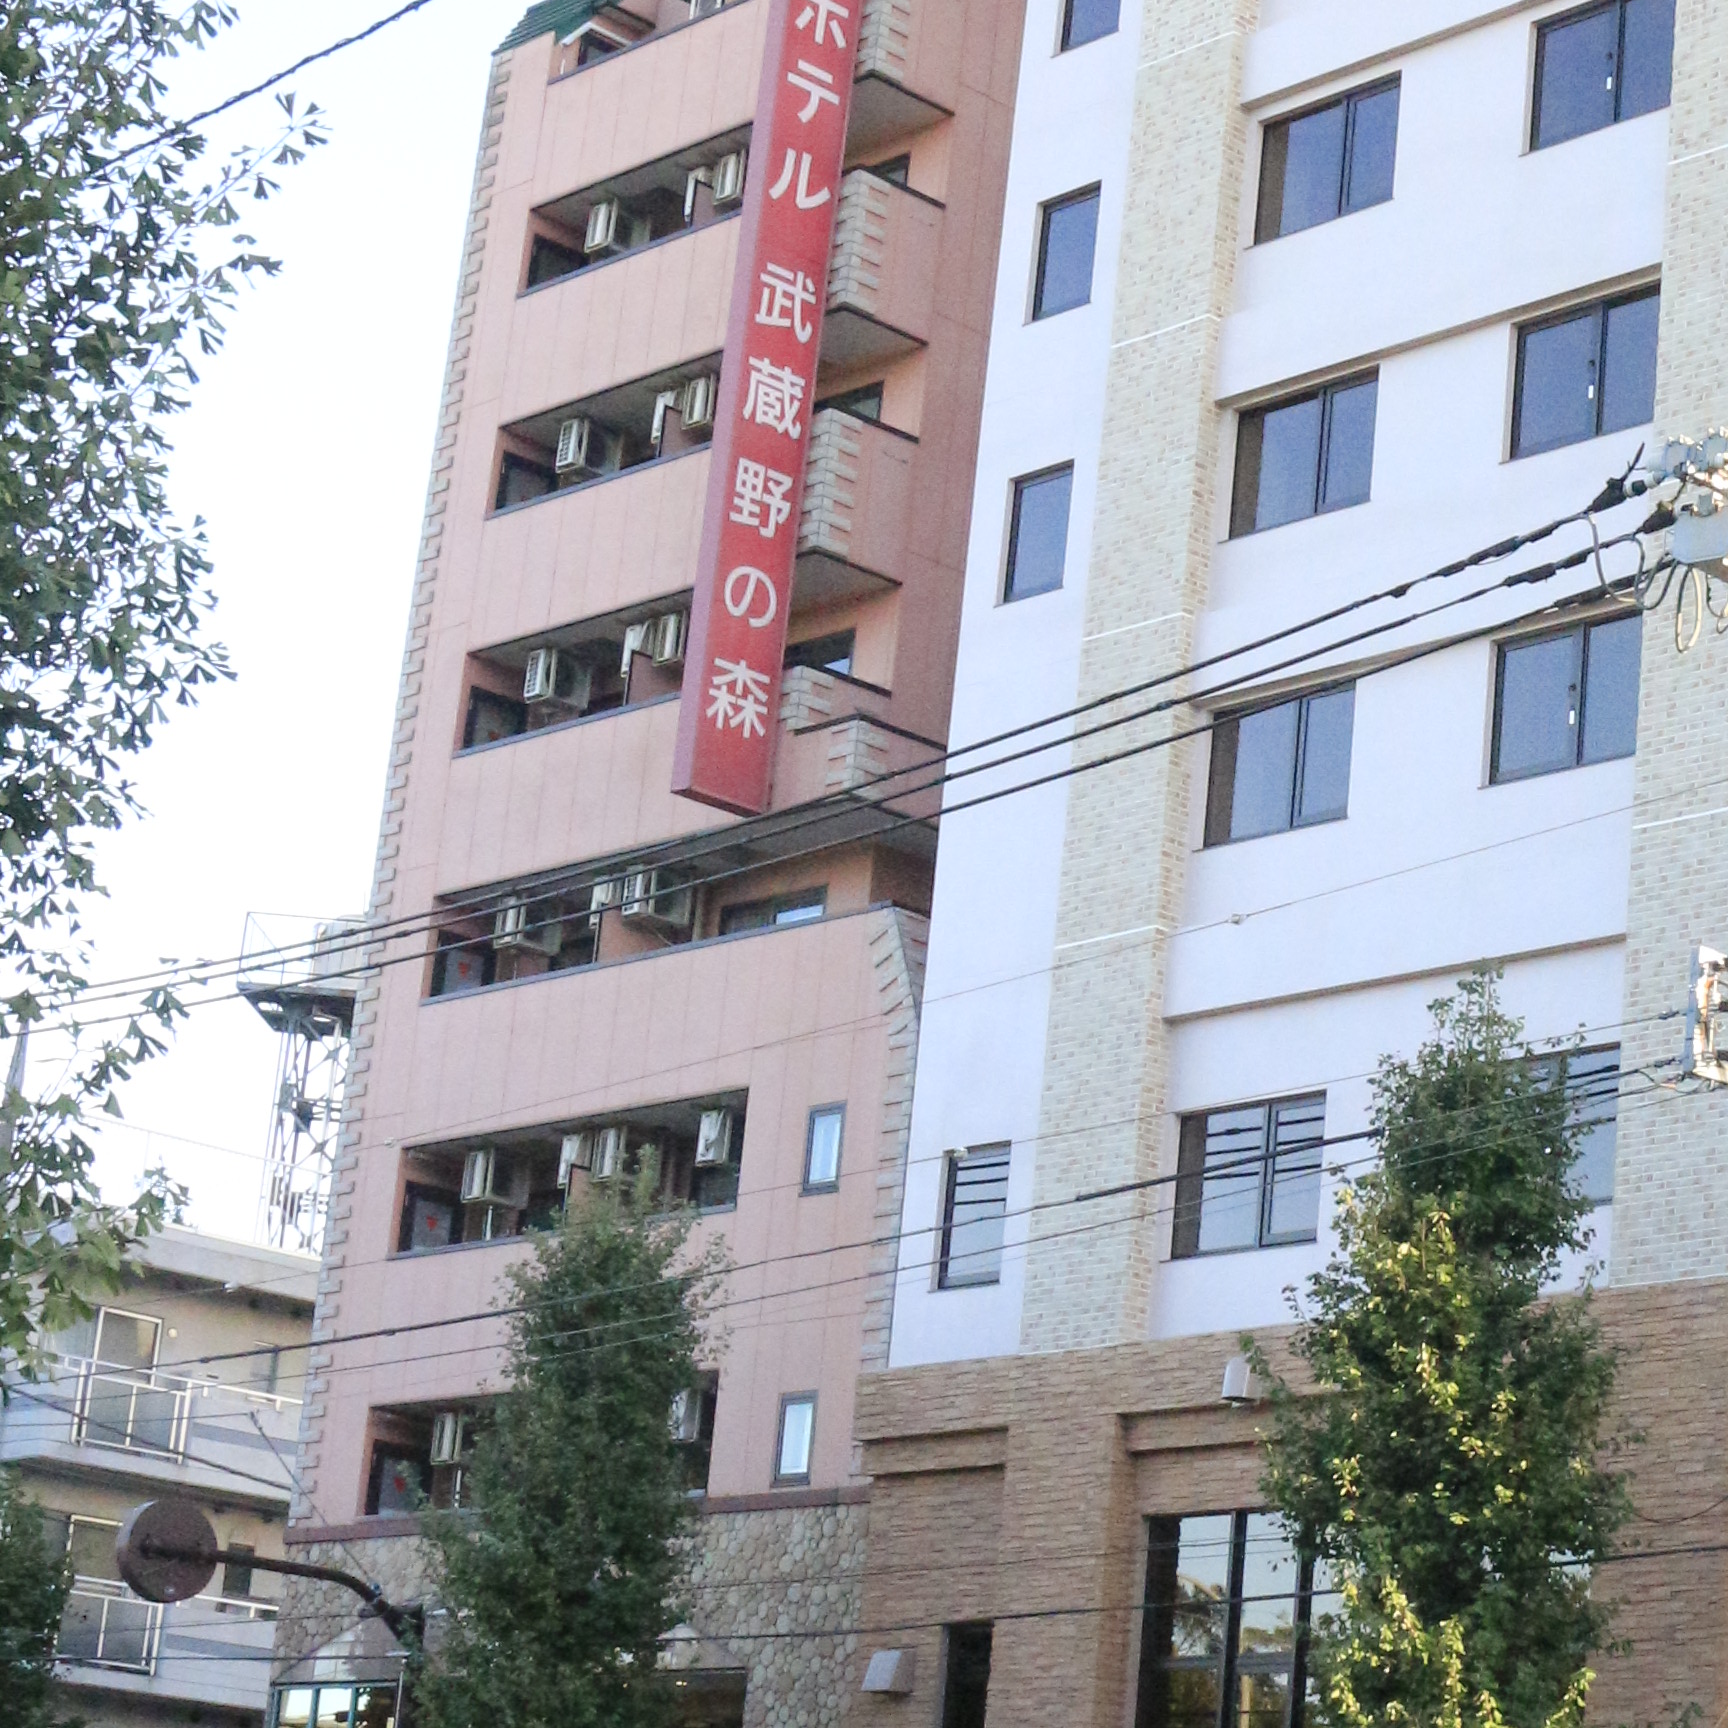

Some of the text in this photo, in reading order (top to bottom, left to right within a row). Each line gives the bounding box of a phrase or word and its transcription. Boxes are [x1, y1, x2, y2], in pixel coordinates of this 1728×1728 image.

[706, 261, 817, 739] 武蔵野の森
